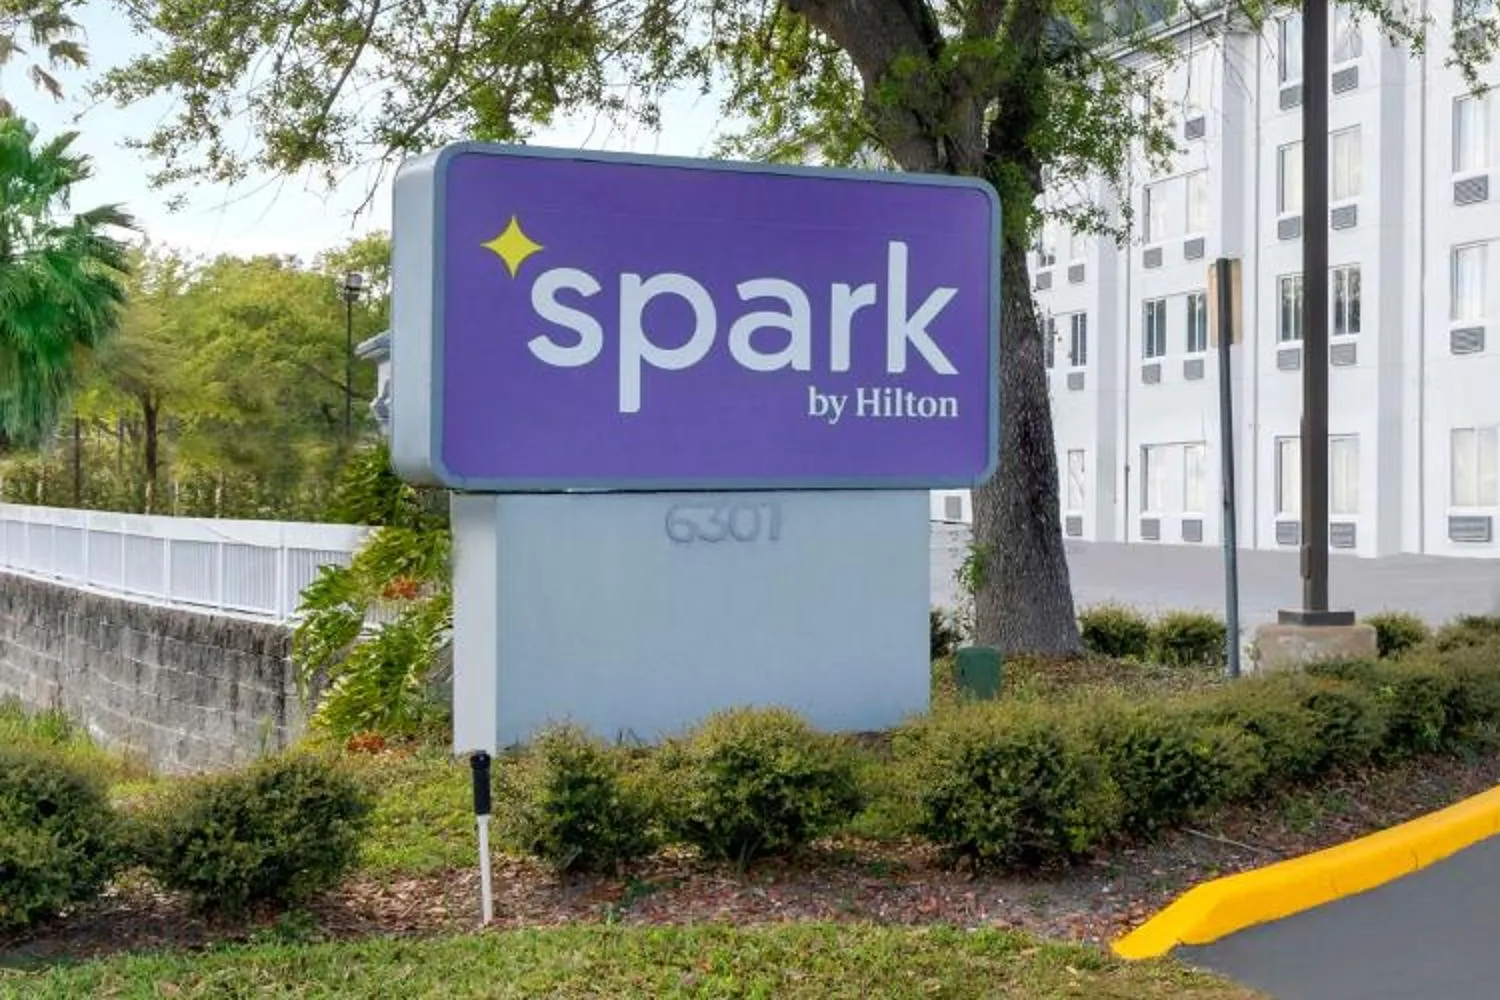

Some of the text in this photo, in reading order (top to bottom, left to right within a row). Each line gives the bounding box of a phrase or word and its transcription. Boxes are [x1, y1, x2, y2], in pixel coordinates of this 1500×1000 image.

[527, 241, 959, 413] spark
[808, 385, 959, 425] by Hilton
[665, 502, 782, 543] 6301
